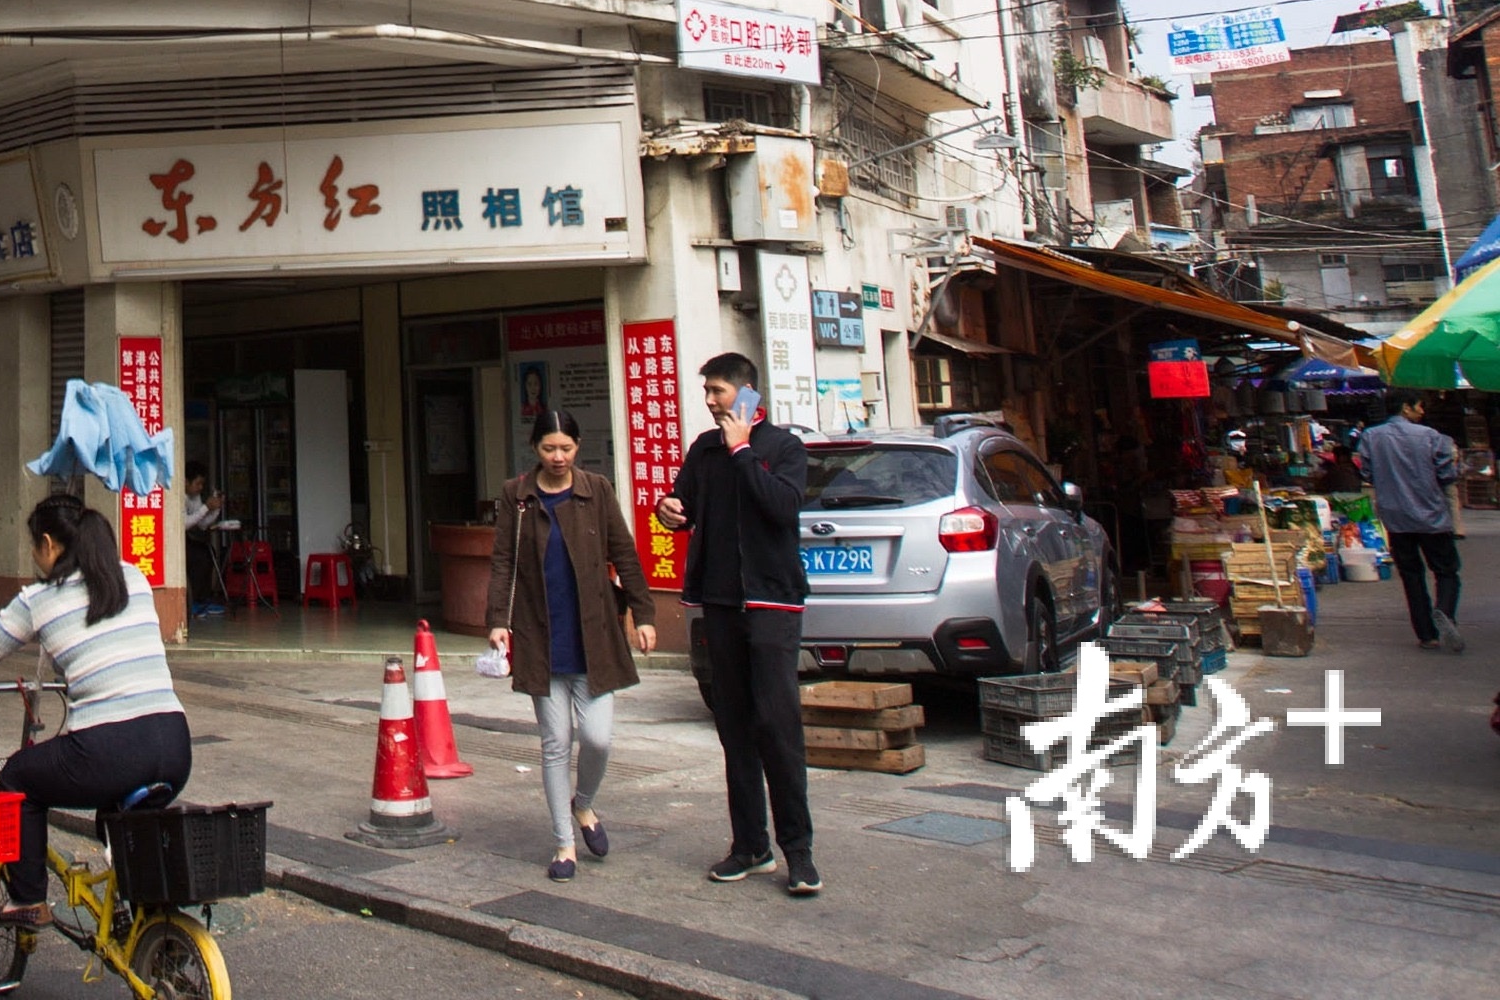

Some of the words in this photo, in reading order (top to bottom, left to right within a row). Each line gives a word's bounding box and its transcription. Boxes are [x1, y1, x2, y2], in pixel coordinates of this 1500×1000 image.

[711, 29, 730, 44] 医院
[730, 20, 812, 57] 口腔门诊部
[724, 53, 774, 70] 由此进20m
[142, 155, 382, 243] 东方红
[421, 185, 585, 231] 照相馆
[768, 312, 809, 331] 莞城医院
[819, 322, 839, 339] WC
[842, 323, 863, 341] 公厕
[627, 337, 649, 506] 从业资格证照片
[659, 334, 682, 497] 东莞市社保卡回
[130, 515, 156, 576] 摄影点
